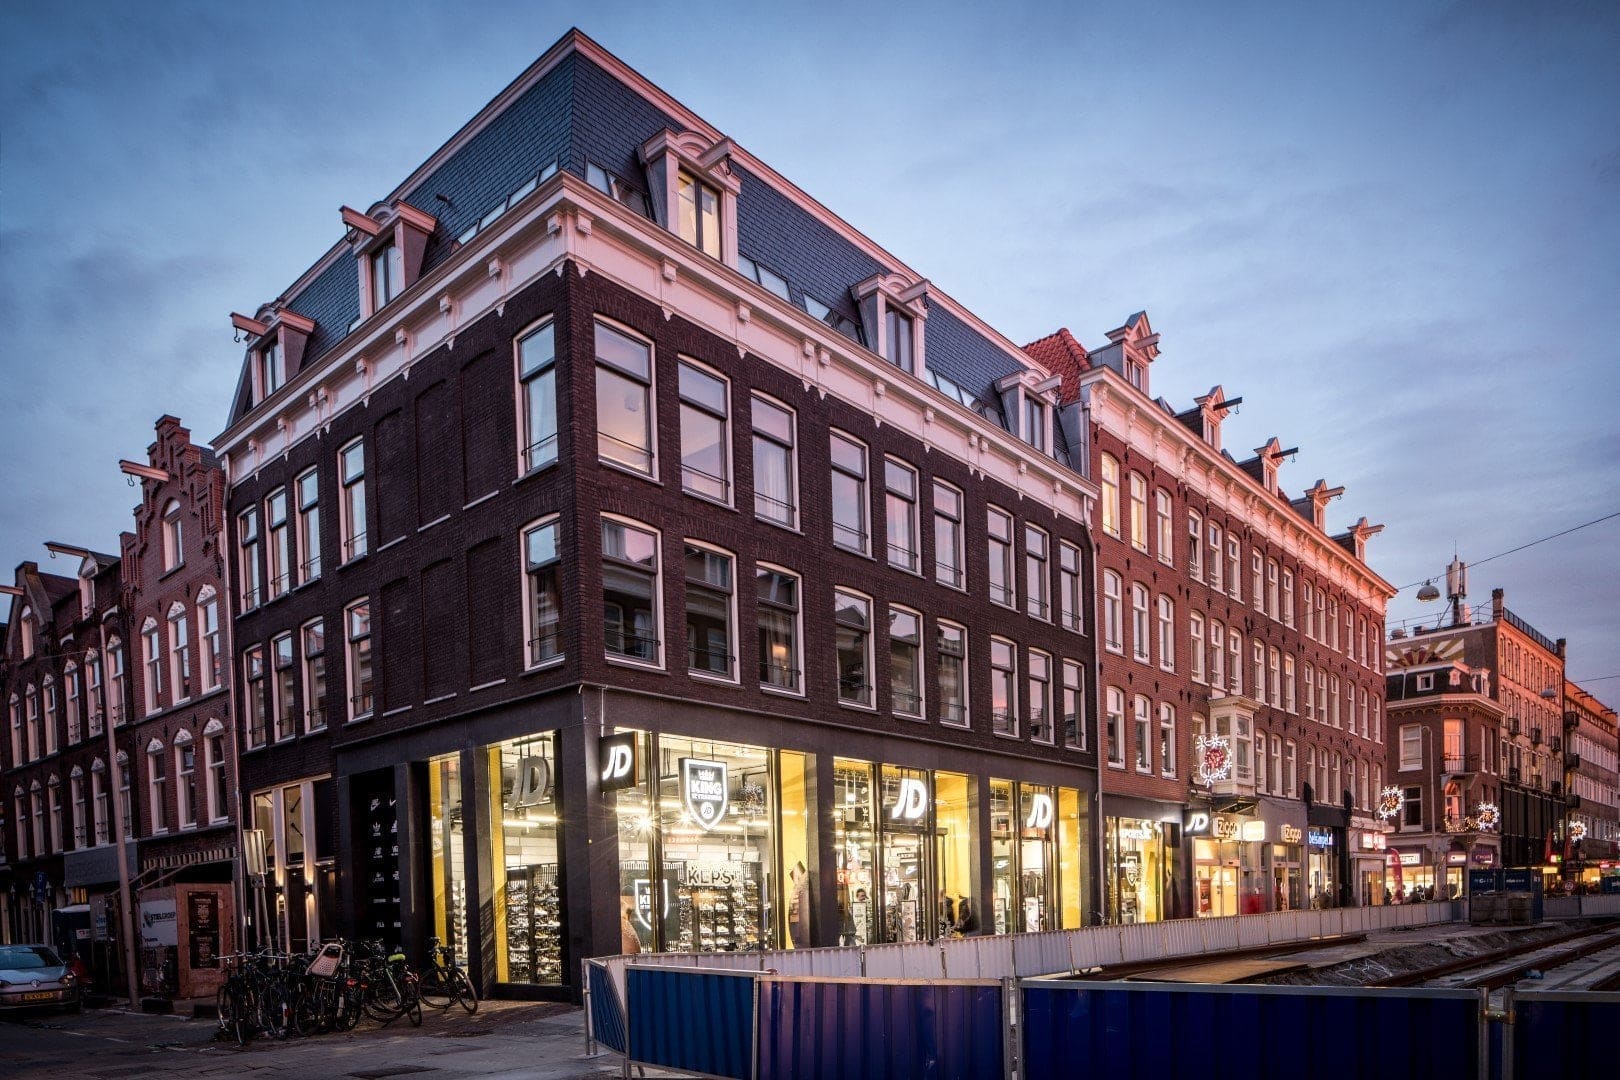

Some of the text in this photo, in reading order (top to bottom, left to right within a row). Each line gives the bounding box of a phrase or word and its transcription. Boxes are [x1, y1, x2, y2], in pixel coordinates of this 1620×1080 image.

[603, 745, 632, 780] JD
[506, 756, 550, 811] JD
[691, 780, 722, 795] KING
[892, 779, 927, 819] JD
[1027, 794, 1054, 828] JD
[1185, 813, 1208, 831] JD
